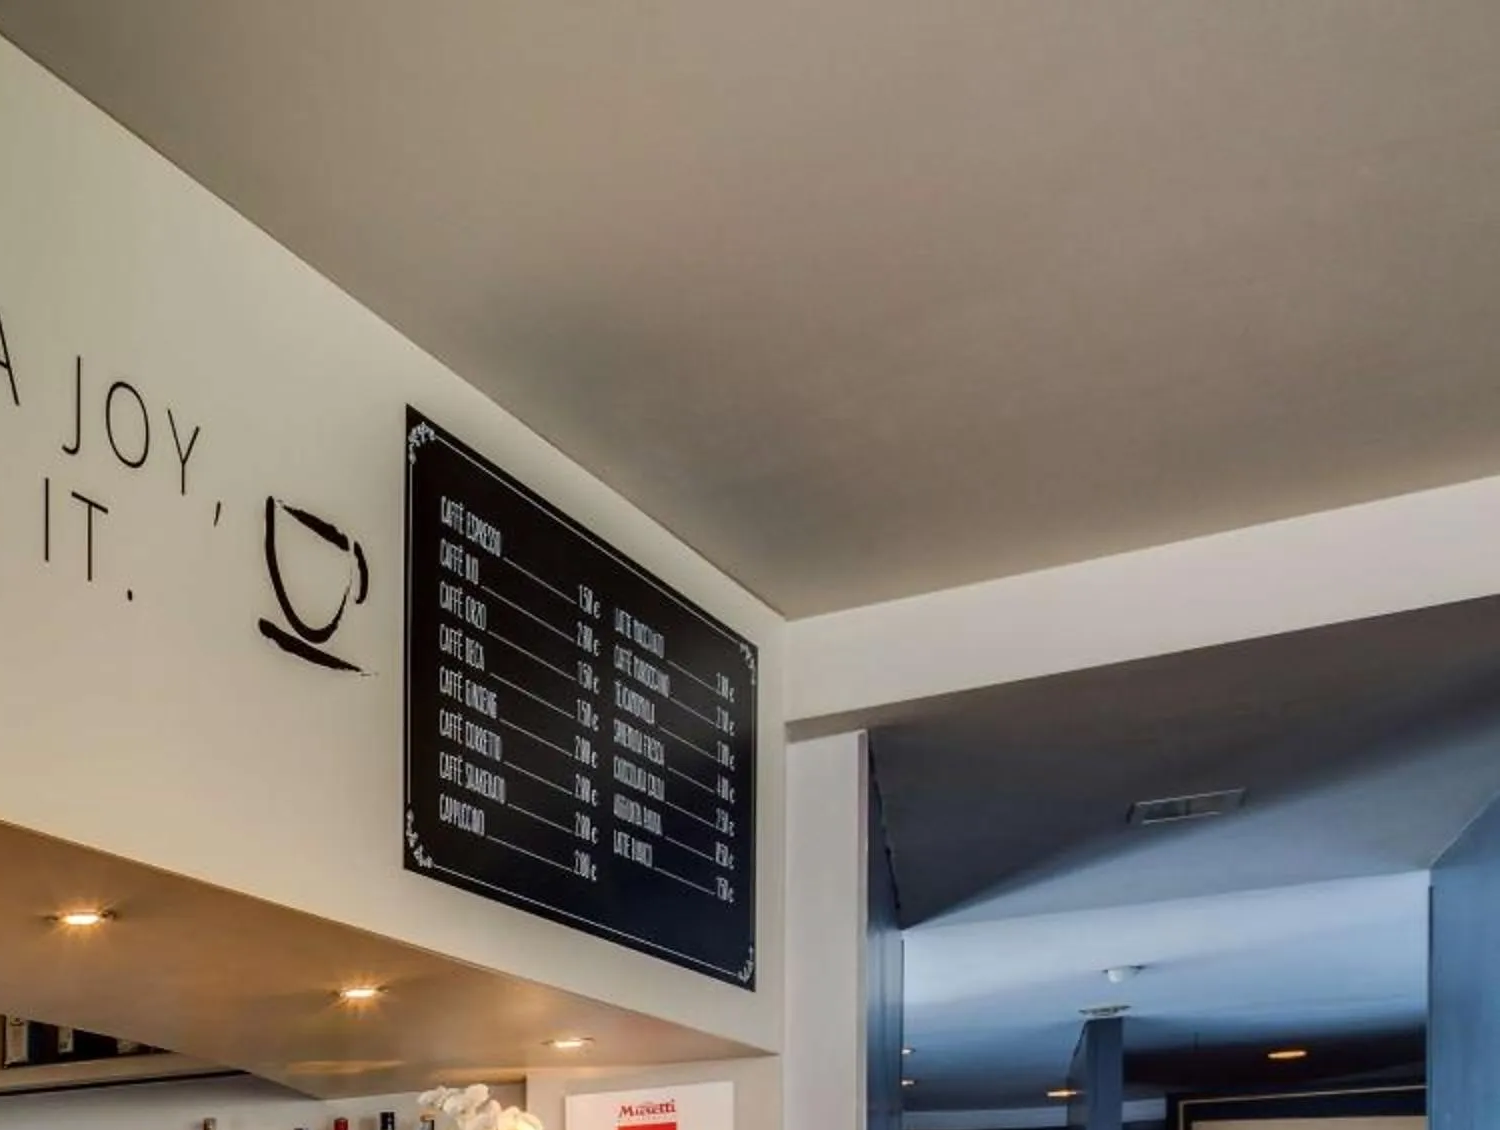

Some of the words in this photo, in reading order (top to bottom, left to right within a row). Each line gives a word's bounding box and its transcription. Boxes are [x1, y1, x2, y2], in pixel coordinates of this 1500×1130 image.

[61, 354, 222, 528] JOY,
[43, 477, 134, 602] IT.
[618, 1099, 676, 1118] Musetti
